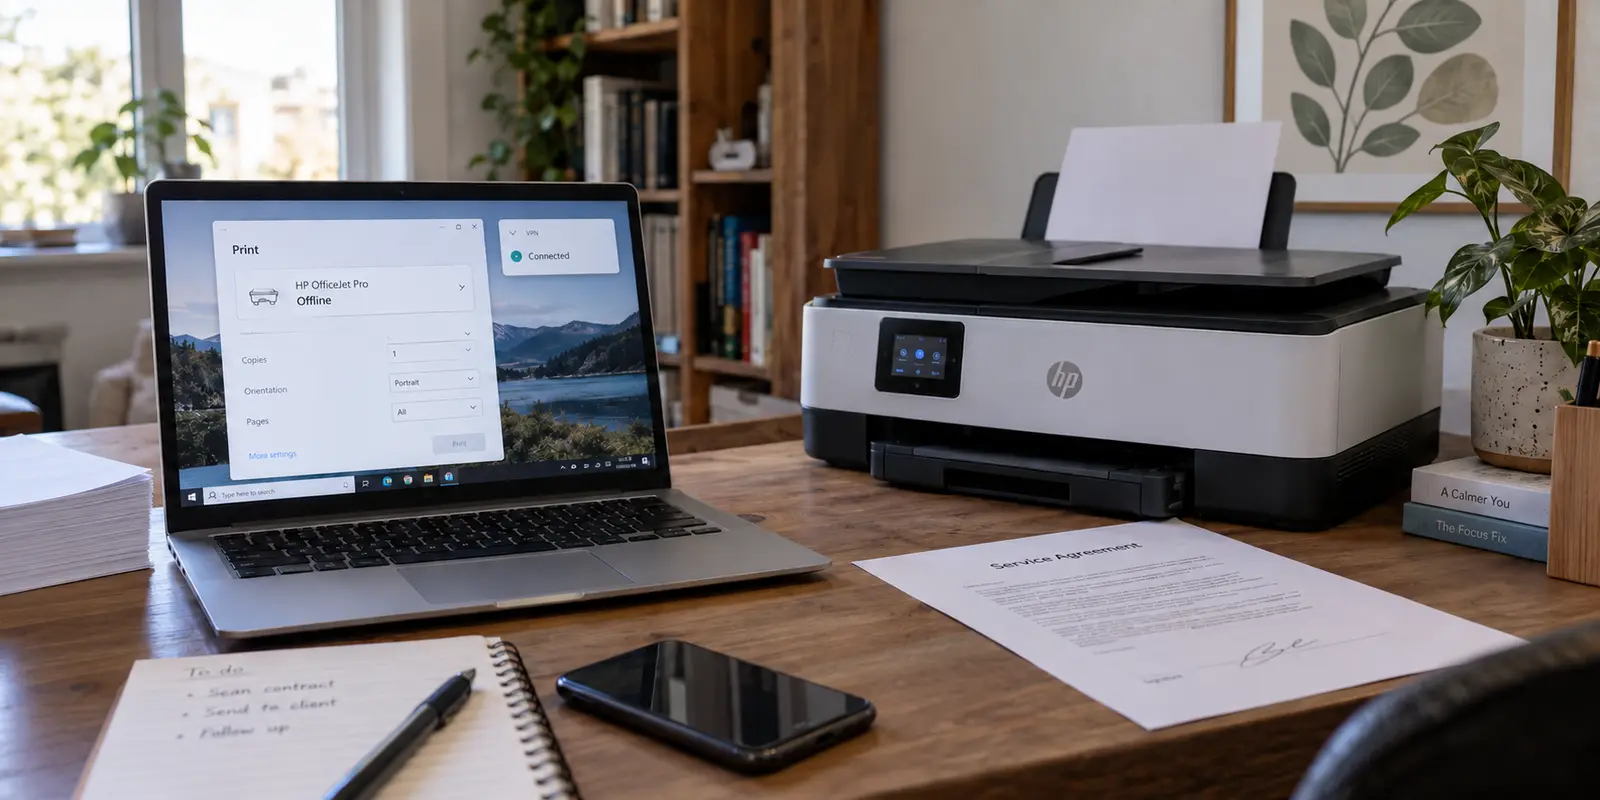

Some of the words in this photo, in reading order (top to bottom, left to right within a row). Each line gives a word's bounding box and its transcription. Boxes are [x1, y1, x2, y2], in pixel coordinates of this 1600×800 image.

[232, 244, 259, 255] Print
[528, 252, 570, 260] Connected
[295, 281, 309, 290] HP
[311, 279, 351, 290] OfficeJet
[353, 280, 369, 289] Pro
[296, 295, 332, 306] Offline
[241, 355, 267, 366] Copies
[394, 378, 420, 387] Portrait
[1051, 361, 1079, 399] hp
[244, 385, 288, 395] Orientation
[397, 408, 407, 416] All
[246, 417, 269, 427] Pages
[248, 452, 269, 460] More
[269, 450, 297, 460] settings
[1440, 486, 1449, 498] A
[1451, 488, 1488, 504] Calmer
[1491, 495, 1511, 509] You
[1436, 519, 1456, 534] The
[1458, 524, 1489, 541] Focus
[1491, 530, 1507, 544] Fix
[990, 554, 1053, 571] Service
[1055, 541, 1143, 560] Agreement
[184, 666, 210, 678] To
[219, 664, 244, 677] do
